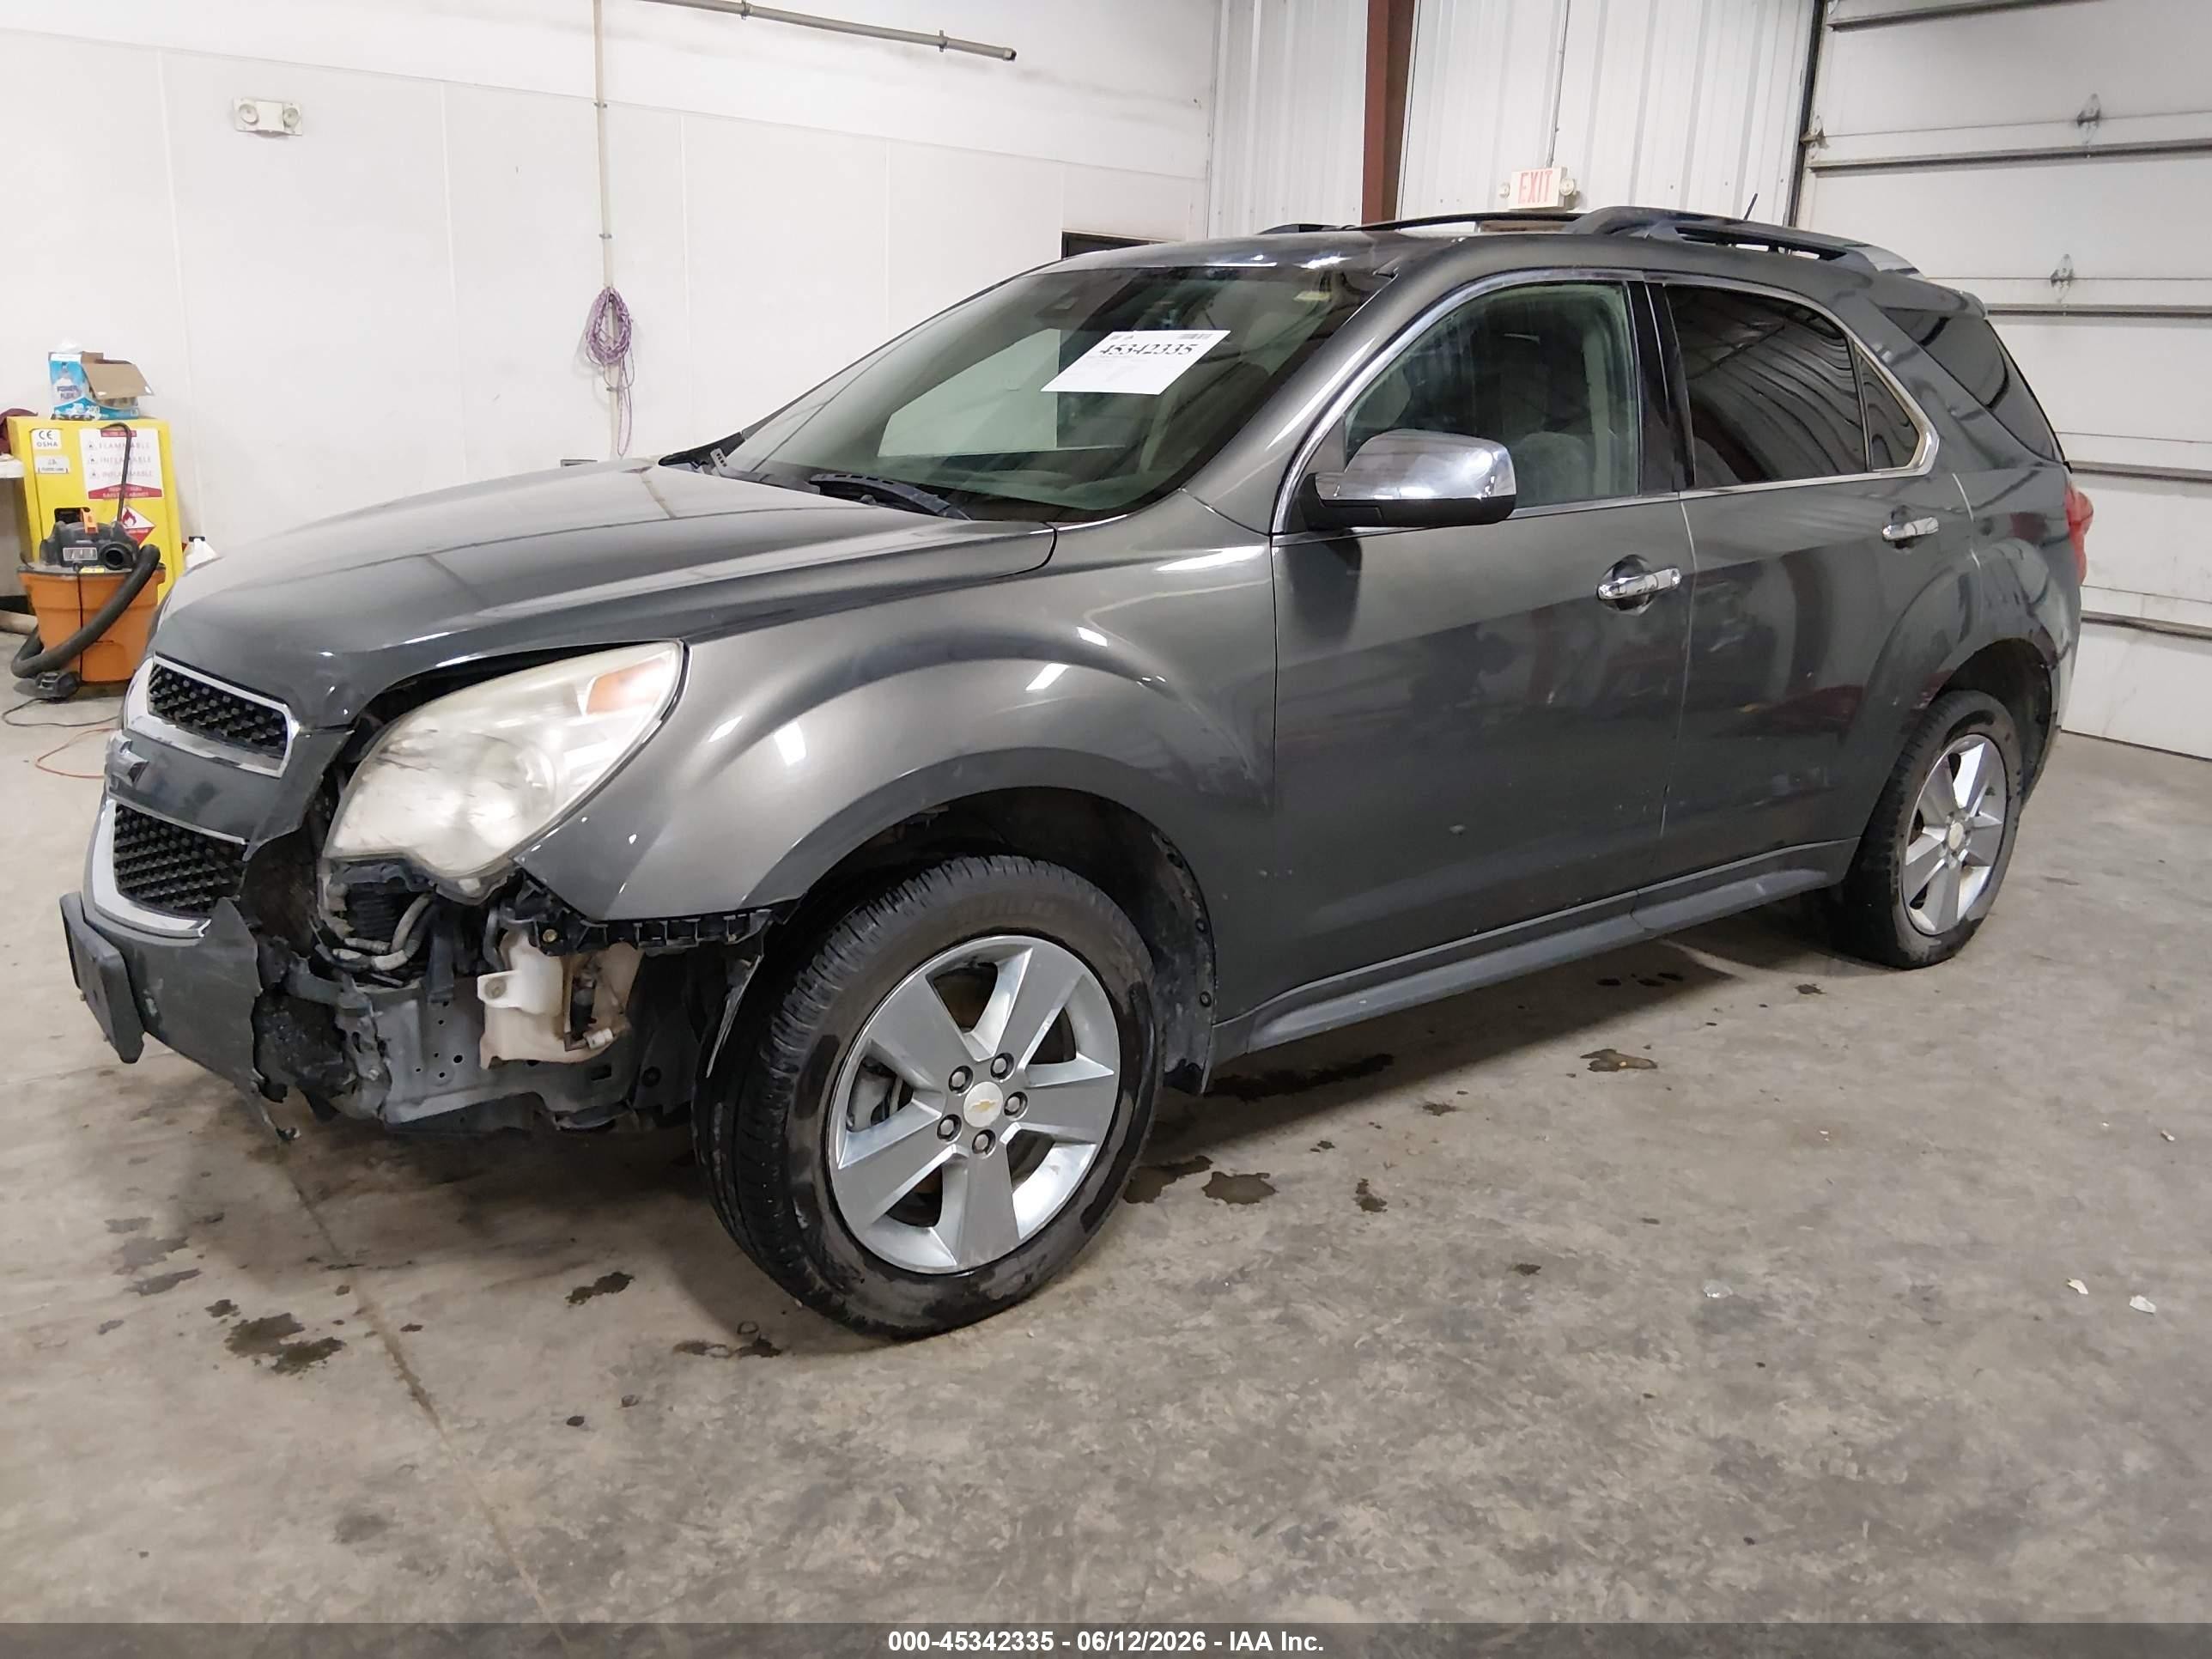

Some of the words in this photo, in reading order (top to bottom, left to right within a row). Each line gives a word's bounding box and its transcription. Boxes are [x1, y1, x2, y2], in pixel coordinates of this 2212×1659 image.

[1518, 170, 1553, 204] EXIT
[1100, 343, 1200, 356] 45342335
[39, 430, 53, 441] CE
